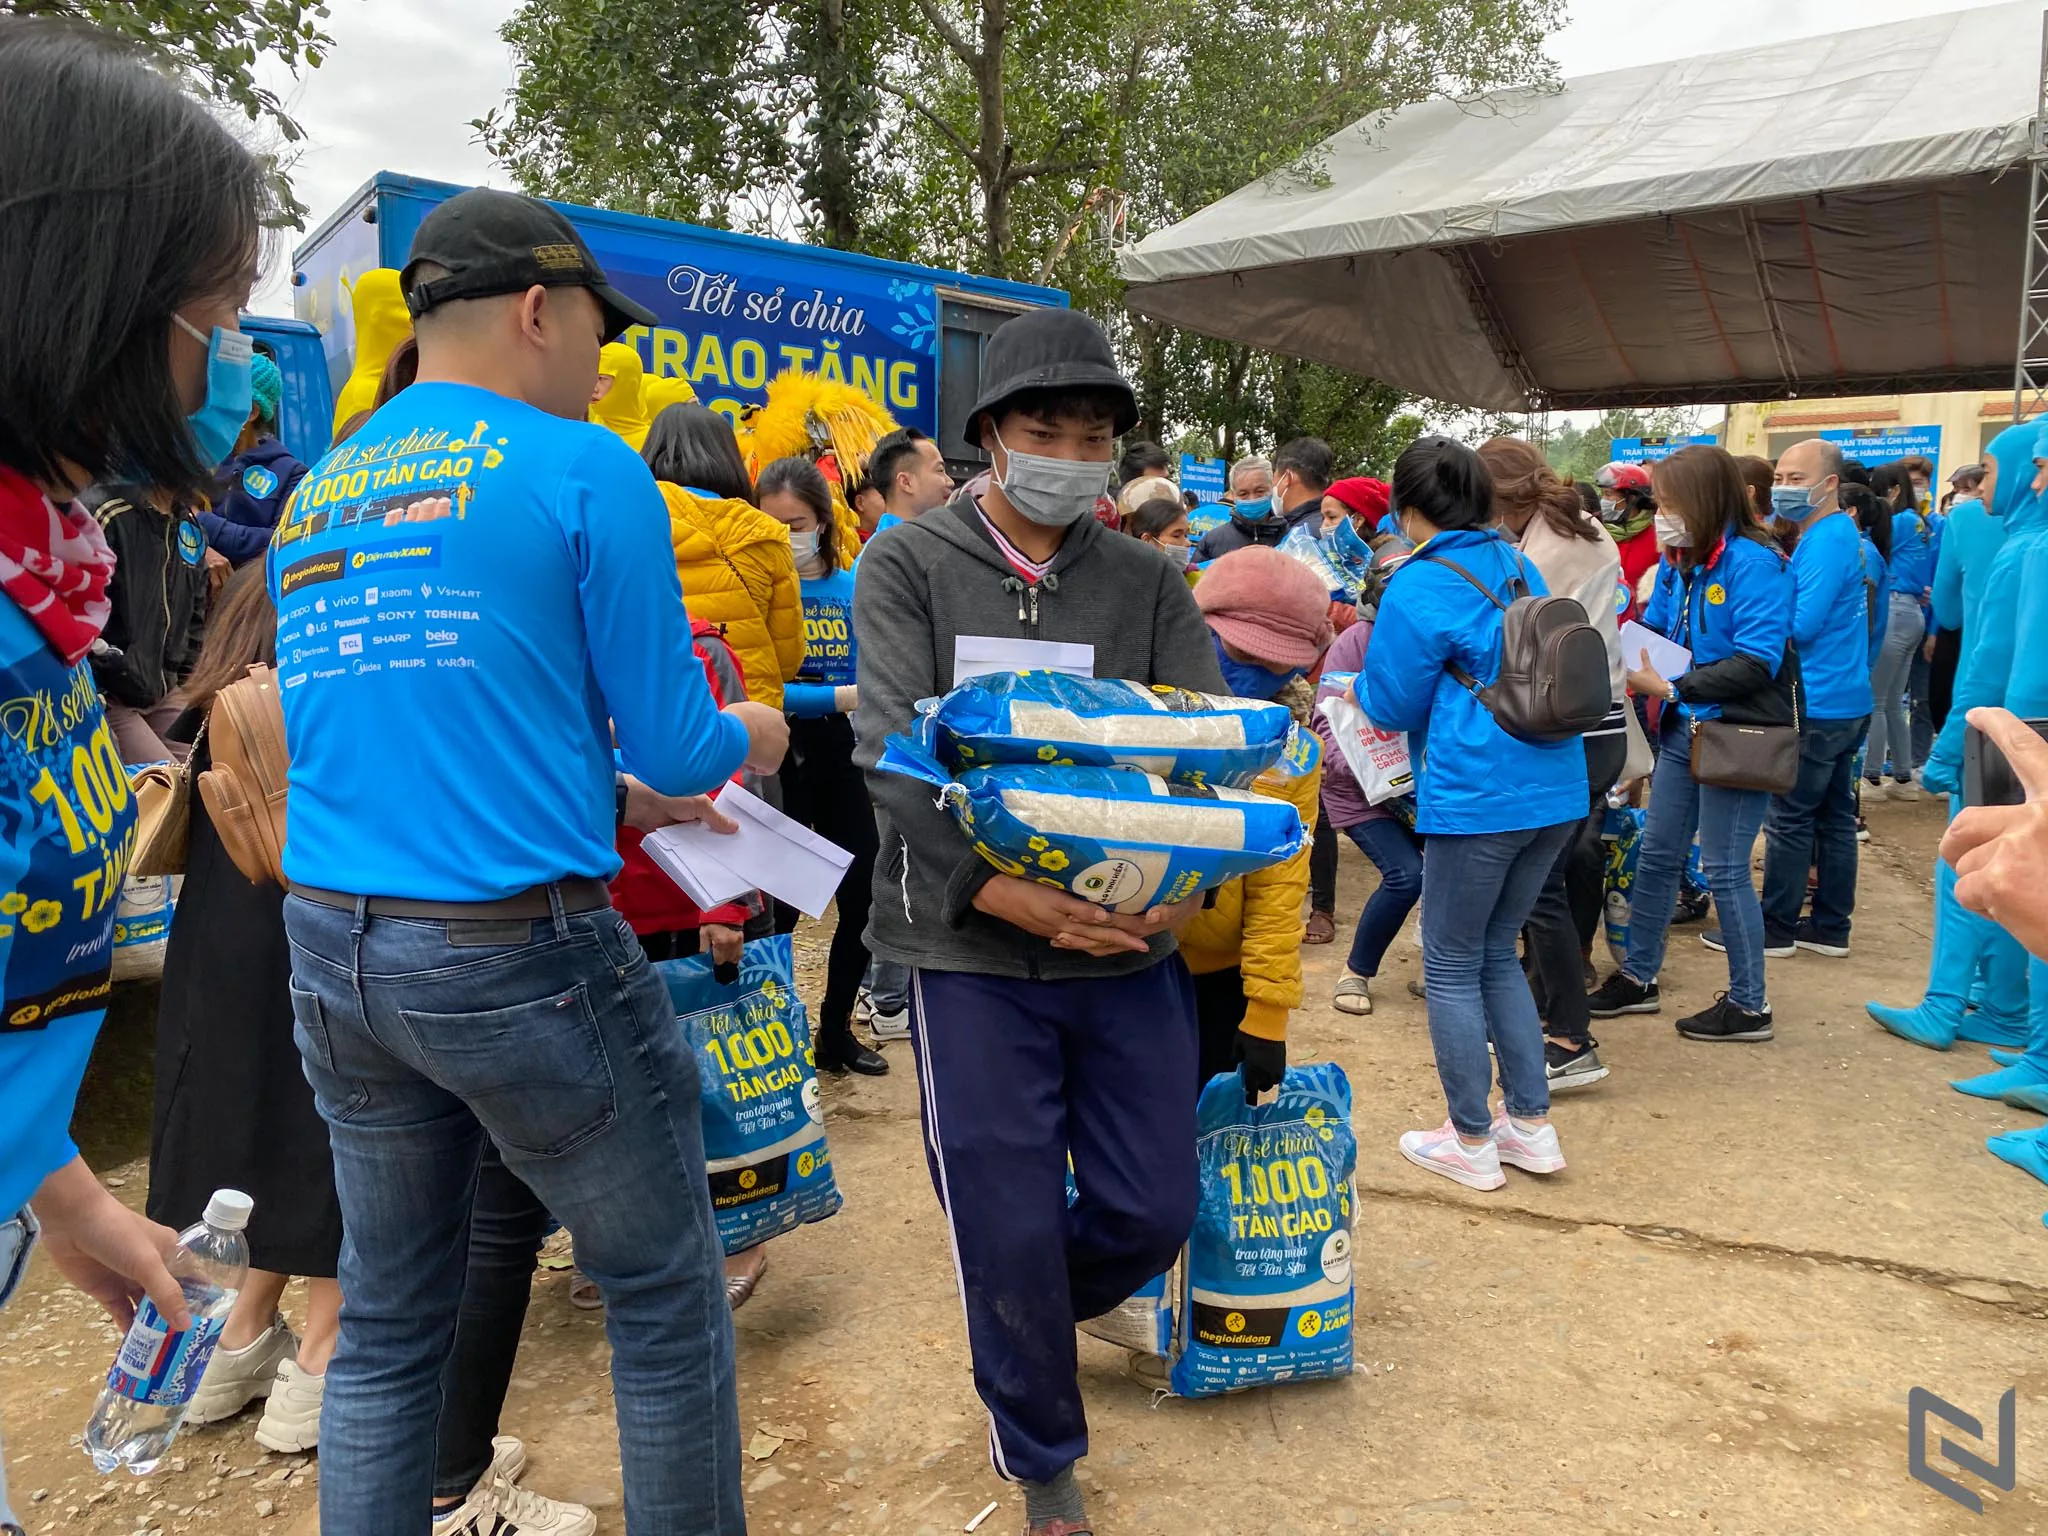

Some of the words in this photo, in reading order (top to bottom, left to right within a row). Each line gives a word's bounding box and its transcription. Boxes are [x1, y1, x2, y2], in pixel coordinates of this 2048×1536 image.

[667, 265, 738, 318] Tết
[743, 286, 784, 323] sẻ
[790, 290, 866, 336] chia
[622, 325, 766, 390] TRAO
[387, 427, 449, 459] chia
[301, 468, 370, 512] 1.000
[372, 457, 416, 489] TẤN
[419, 457, 473, 484] GẠO
[332, 595, 359, 608] vivo
[381, 588, 412, 598] xiaomi
[315, 622, 328, 633] LG
[334, 614, 371, 629] Panasonic
[377, 610, 417, 621] SONY
[424, 609, 481, 620] TOSHIBA
[342, 640, 359, 649] TCL
[372, 633, 412, 645] SHARP
[425, 629, 459, 641] beko
[826, 643, 849, 660] GẠO
[389, 658, 426, 669] PHILIPS
[1372, 748, 1404, 763] HOME
[1376, 753, 1410, 770] CREDIT
[749, 1003, 777, 1026] chia
[705, 1021, 794, 1075] 1.000
[726, 1072, 769, 1102] TẤN
[766, 1063, 803, 1091] GẠO
[1274, 1132, 1315, 1156] chia
[1220, 1156, 1328, 1206] 1.000
[715, 1183, 779, 1206] thegioididong
[1232, 1206, 1280, 1238] TẤN
[1281, 1208, 1332, 1239] GẠO
[1235, 1248, 1258, 1260] trao
[1260, 1247, 1283, 1262] tặng
[1199, 1332, 1272, 1345] thegioididong
[1196, 1364, 1231, 1374] SAMSUNG
[1301, 1359, 1327, 1368] SONY
[1204, 1376, 1227, 1384] AQUA
